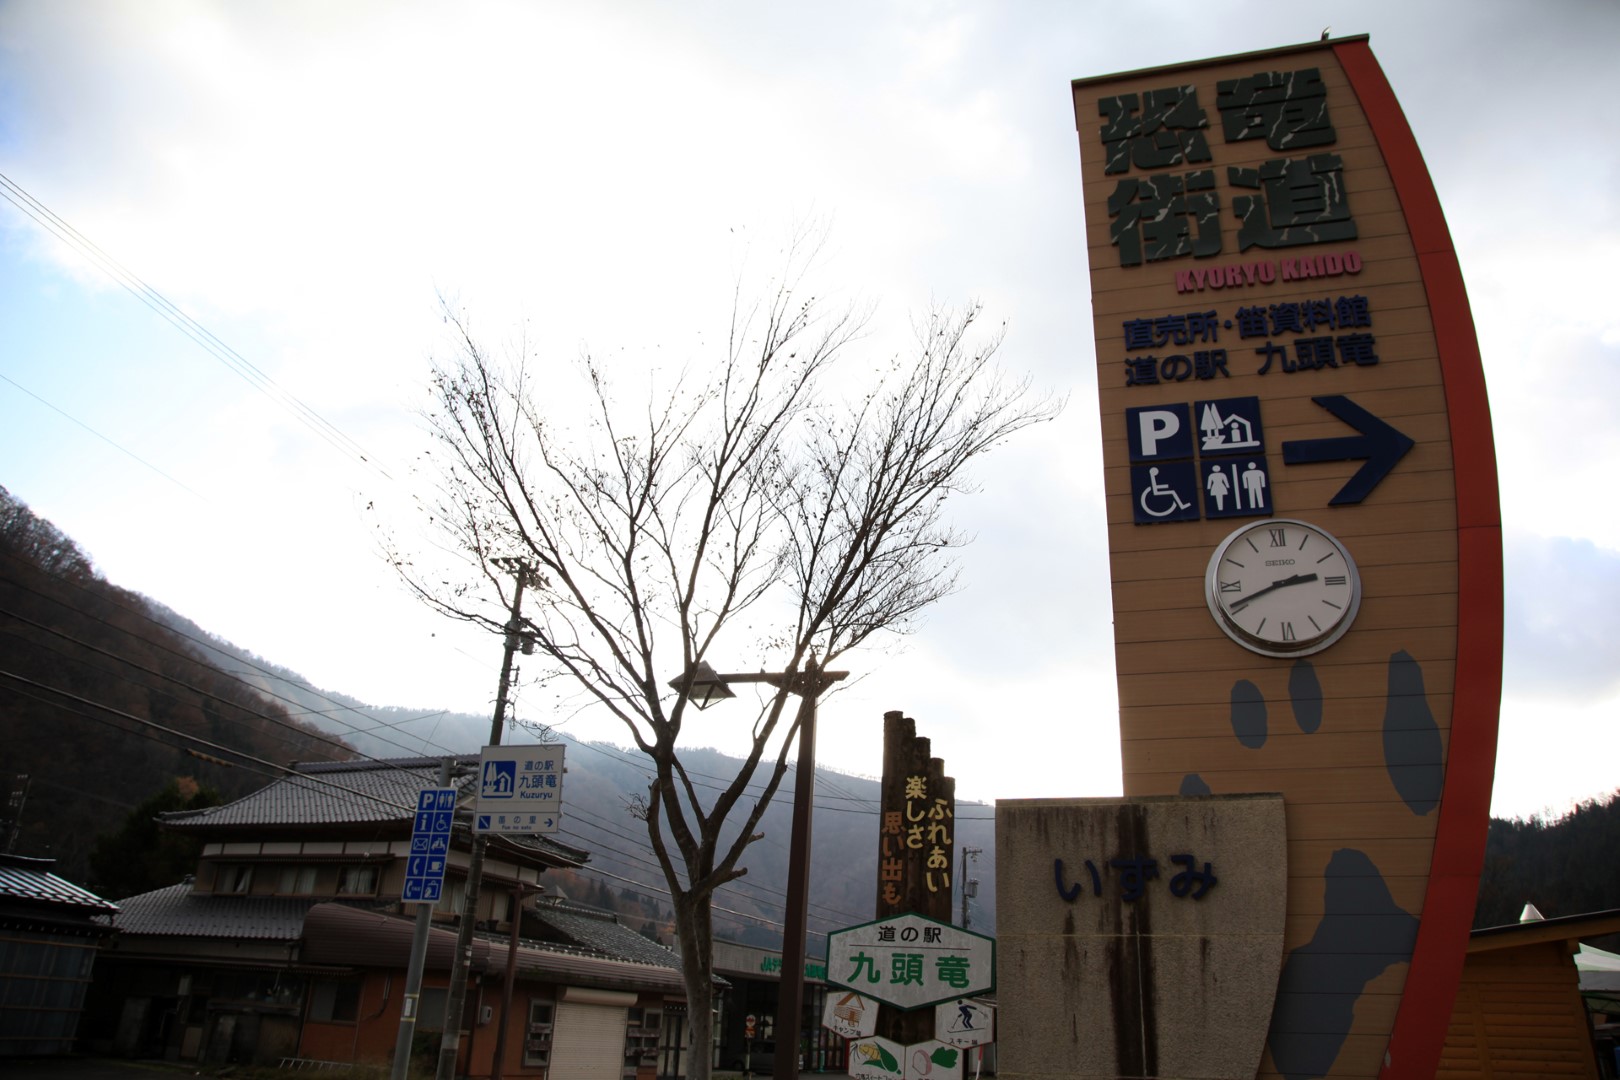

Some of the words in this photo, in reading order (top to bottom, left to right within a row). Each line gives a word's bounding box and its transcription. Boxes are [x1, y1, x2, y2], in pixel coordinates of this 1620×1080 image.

[1098, 67, 1338, 175] 恐竜
[1107, 152, 1358, 268] 街道
[1175, 262, 1277, 294] KYORYU
[1281, 250, 1364, 283] KAIDO
[1124, 348, 1231, 387] 道の駅
[1255, 332, 1380, 376] 九頭竜
[1138, 410, 1181, 457] P
[1265, 558, 1296, 567] SEIKO
[519, 774, 557, 789] 九頭竜
[524, 760, 555, 771] 道の駅
[422, 793, 434, 809] P
[520, 790, 553, 801] Kuzuryu
[905, 775, 927, 849] 楽しさ
[881, 811, 906, 905] 思い出も
[926, 798, 953, 893] ふれあい
[1055, 854, 1218, 903] いずみ
[878, 925, 942, 944] 道の駅
[847, 951, 971, 989] 九頭竜
